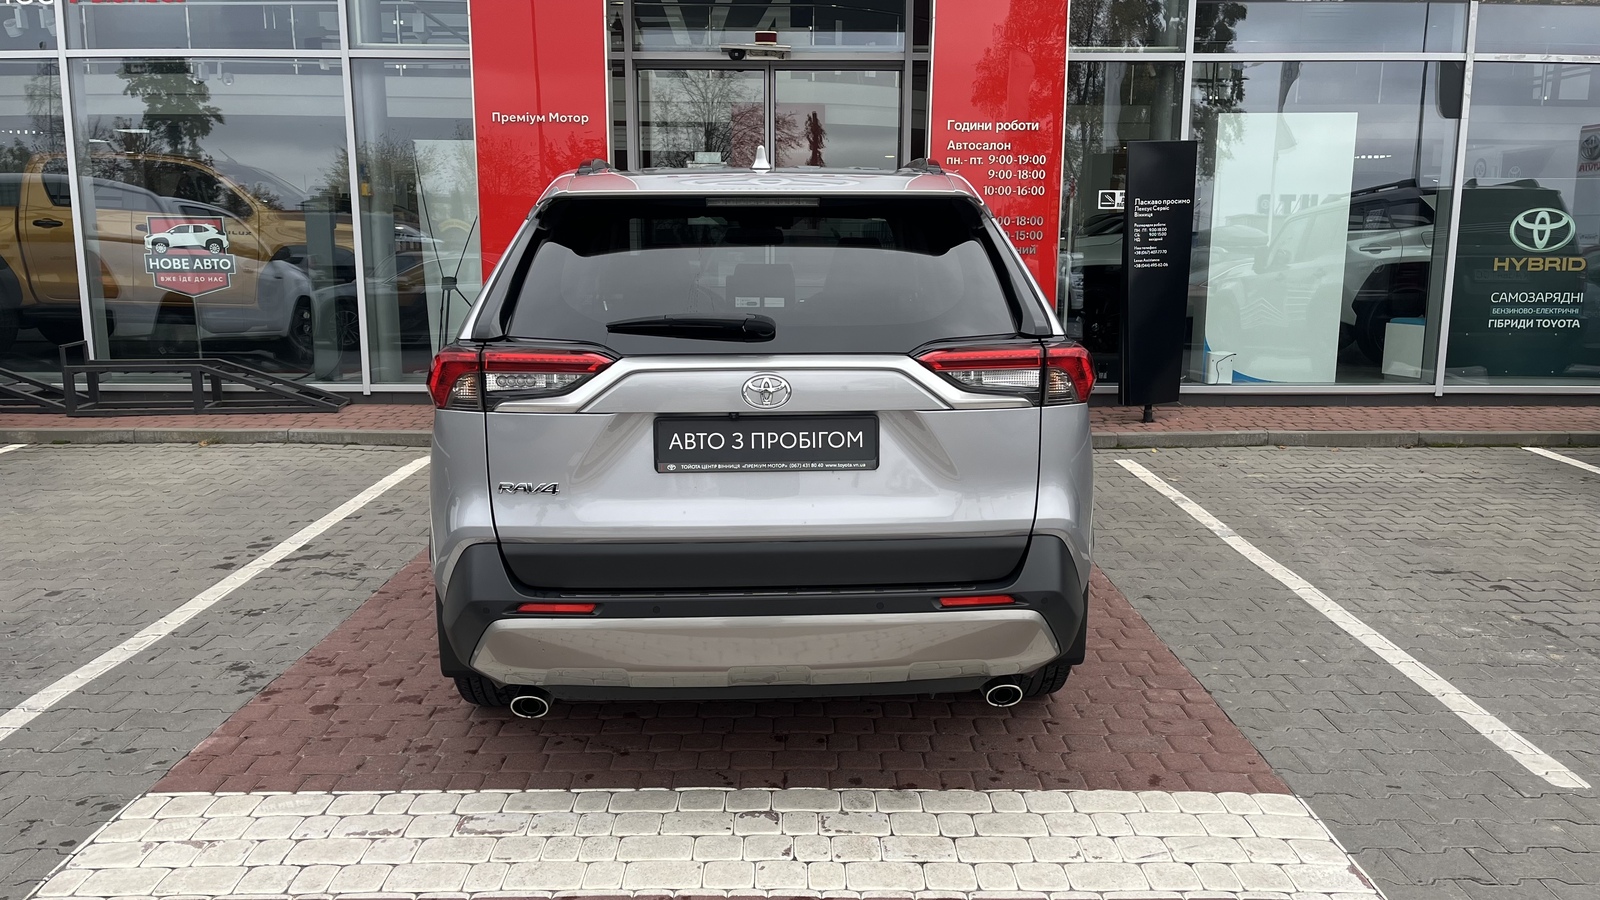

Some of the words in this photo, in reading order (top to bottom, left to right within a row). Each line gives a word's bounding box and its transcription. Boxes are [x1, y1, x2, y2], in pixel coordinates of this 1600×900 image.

[491, 112, 546, 125] Преміум
[549, 112, 589, 125] Мотор
[947, 119, 992, 133] Години
[996, 119, 1039, 133] роботи
[947, 140, 1011, 150] Автосалон
[988, 154, 1047, 165] 9:00-19:00
[987, 169, 1046, 180] 9:00-18:00
[983, 185, 1045, 196] 10:00-16:00
[997, 216, 1044, 226] 00-18:00
[149, 258, 190, 270] НОВЕ
[193, 258, 231, 270] АВТО
[1493, 257, 1587, 272] HYBRID
[1490, 292, 1584, 304] САМОЗАРЯДНІ
[1492, 307, 1580, 315] БЕНЗИНОВО-ЕЛЕКТРИЧНІ
[1488, 319, 1534, 329] ГІБРИДИ
[1535, 319, 1581, 328] TOYOTA
[668, 432, 725, 450] АВТО
[731, 433, 744, 450] З
[751, 431, 864, 449] ПРОБІГОМ
[498, 481, 560, 496] RAV4
